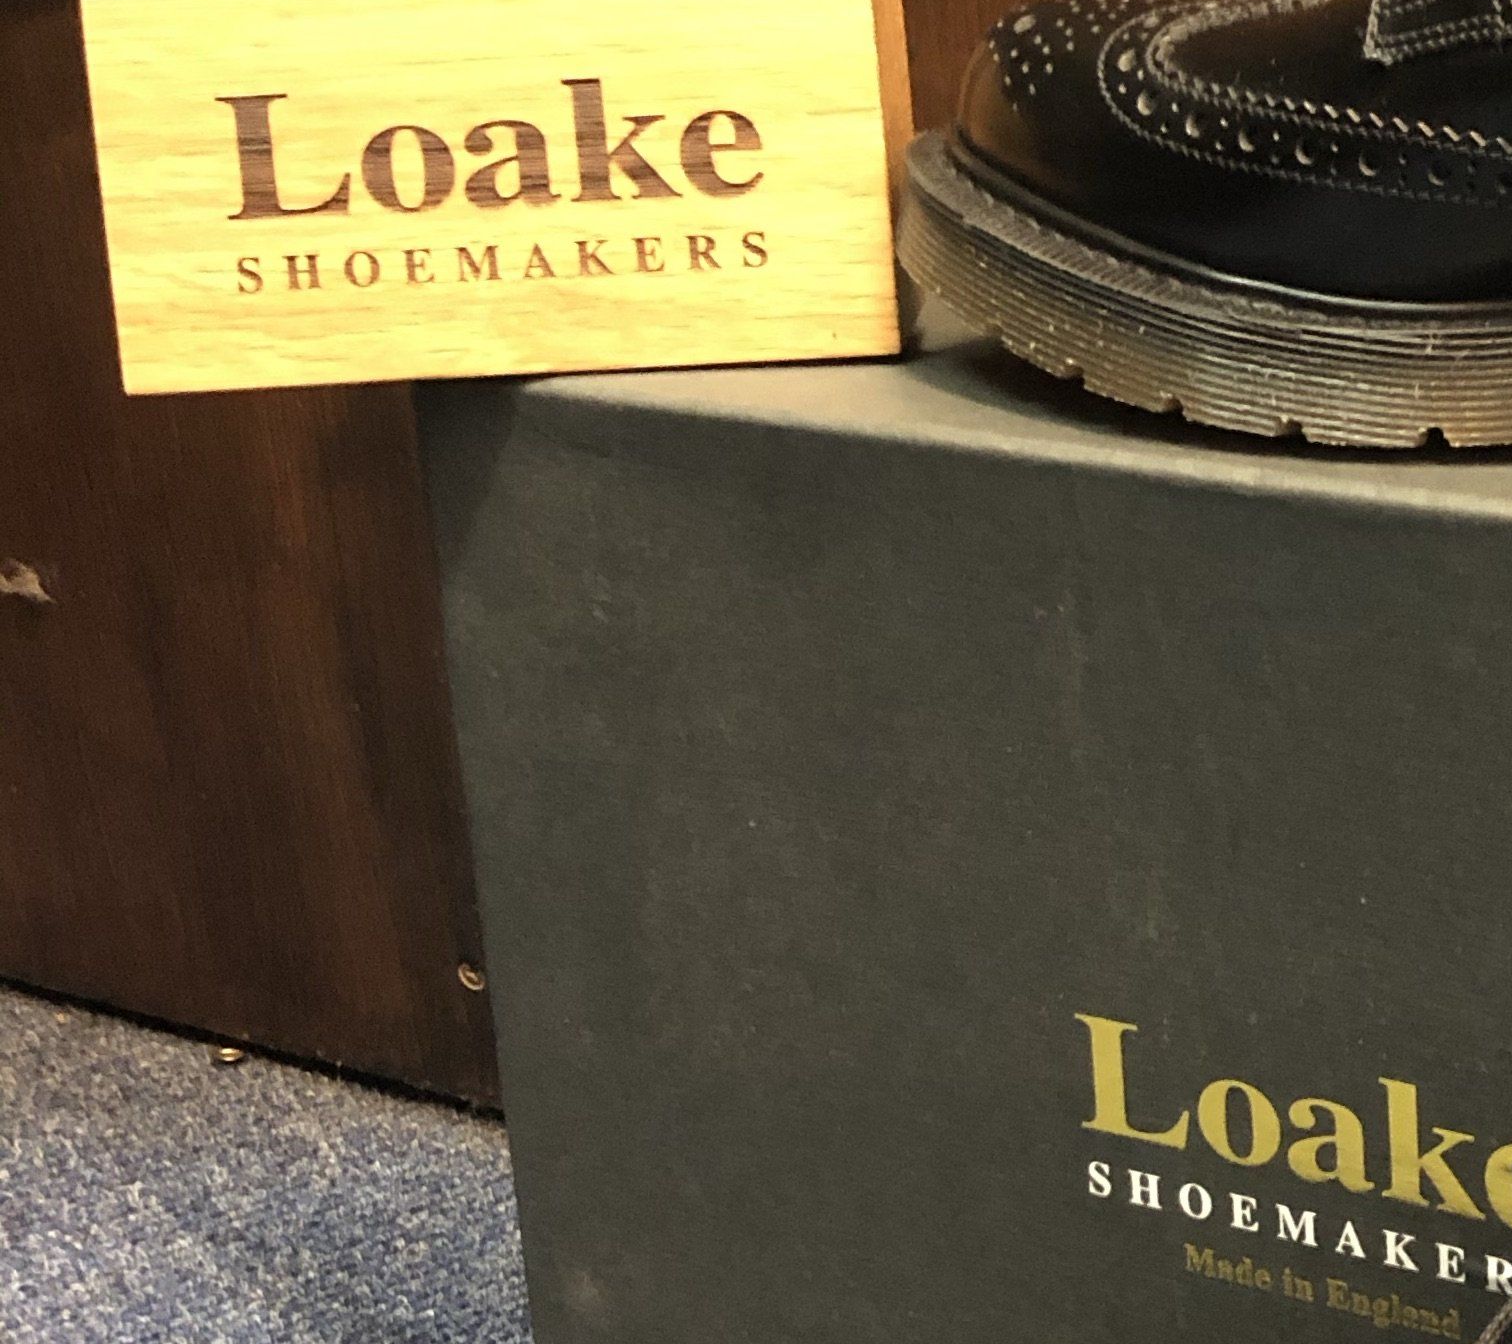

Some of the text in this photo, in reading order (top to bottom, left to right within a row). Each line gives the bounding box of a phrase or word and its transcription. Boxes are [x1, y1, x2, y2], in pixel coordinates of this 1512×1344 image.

[214, 78, 764, 220] Loake
[236, 231, 769, 294] SHOEMAKERS
[1183, 1243, 1463, 1341] Made in England
